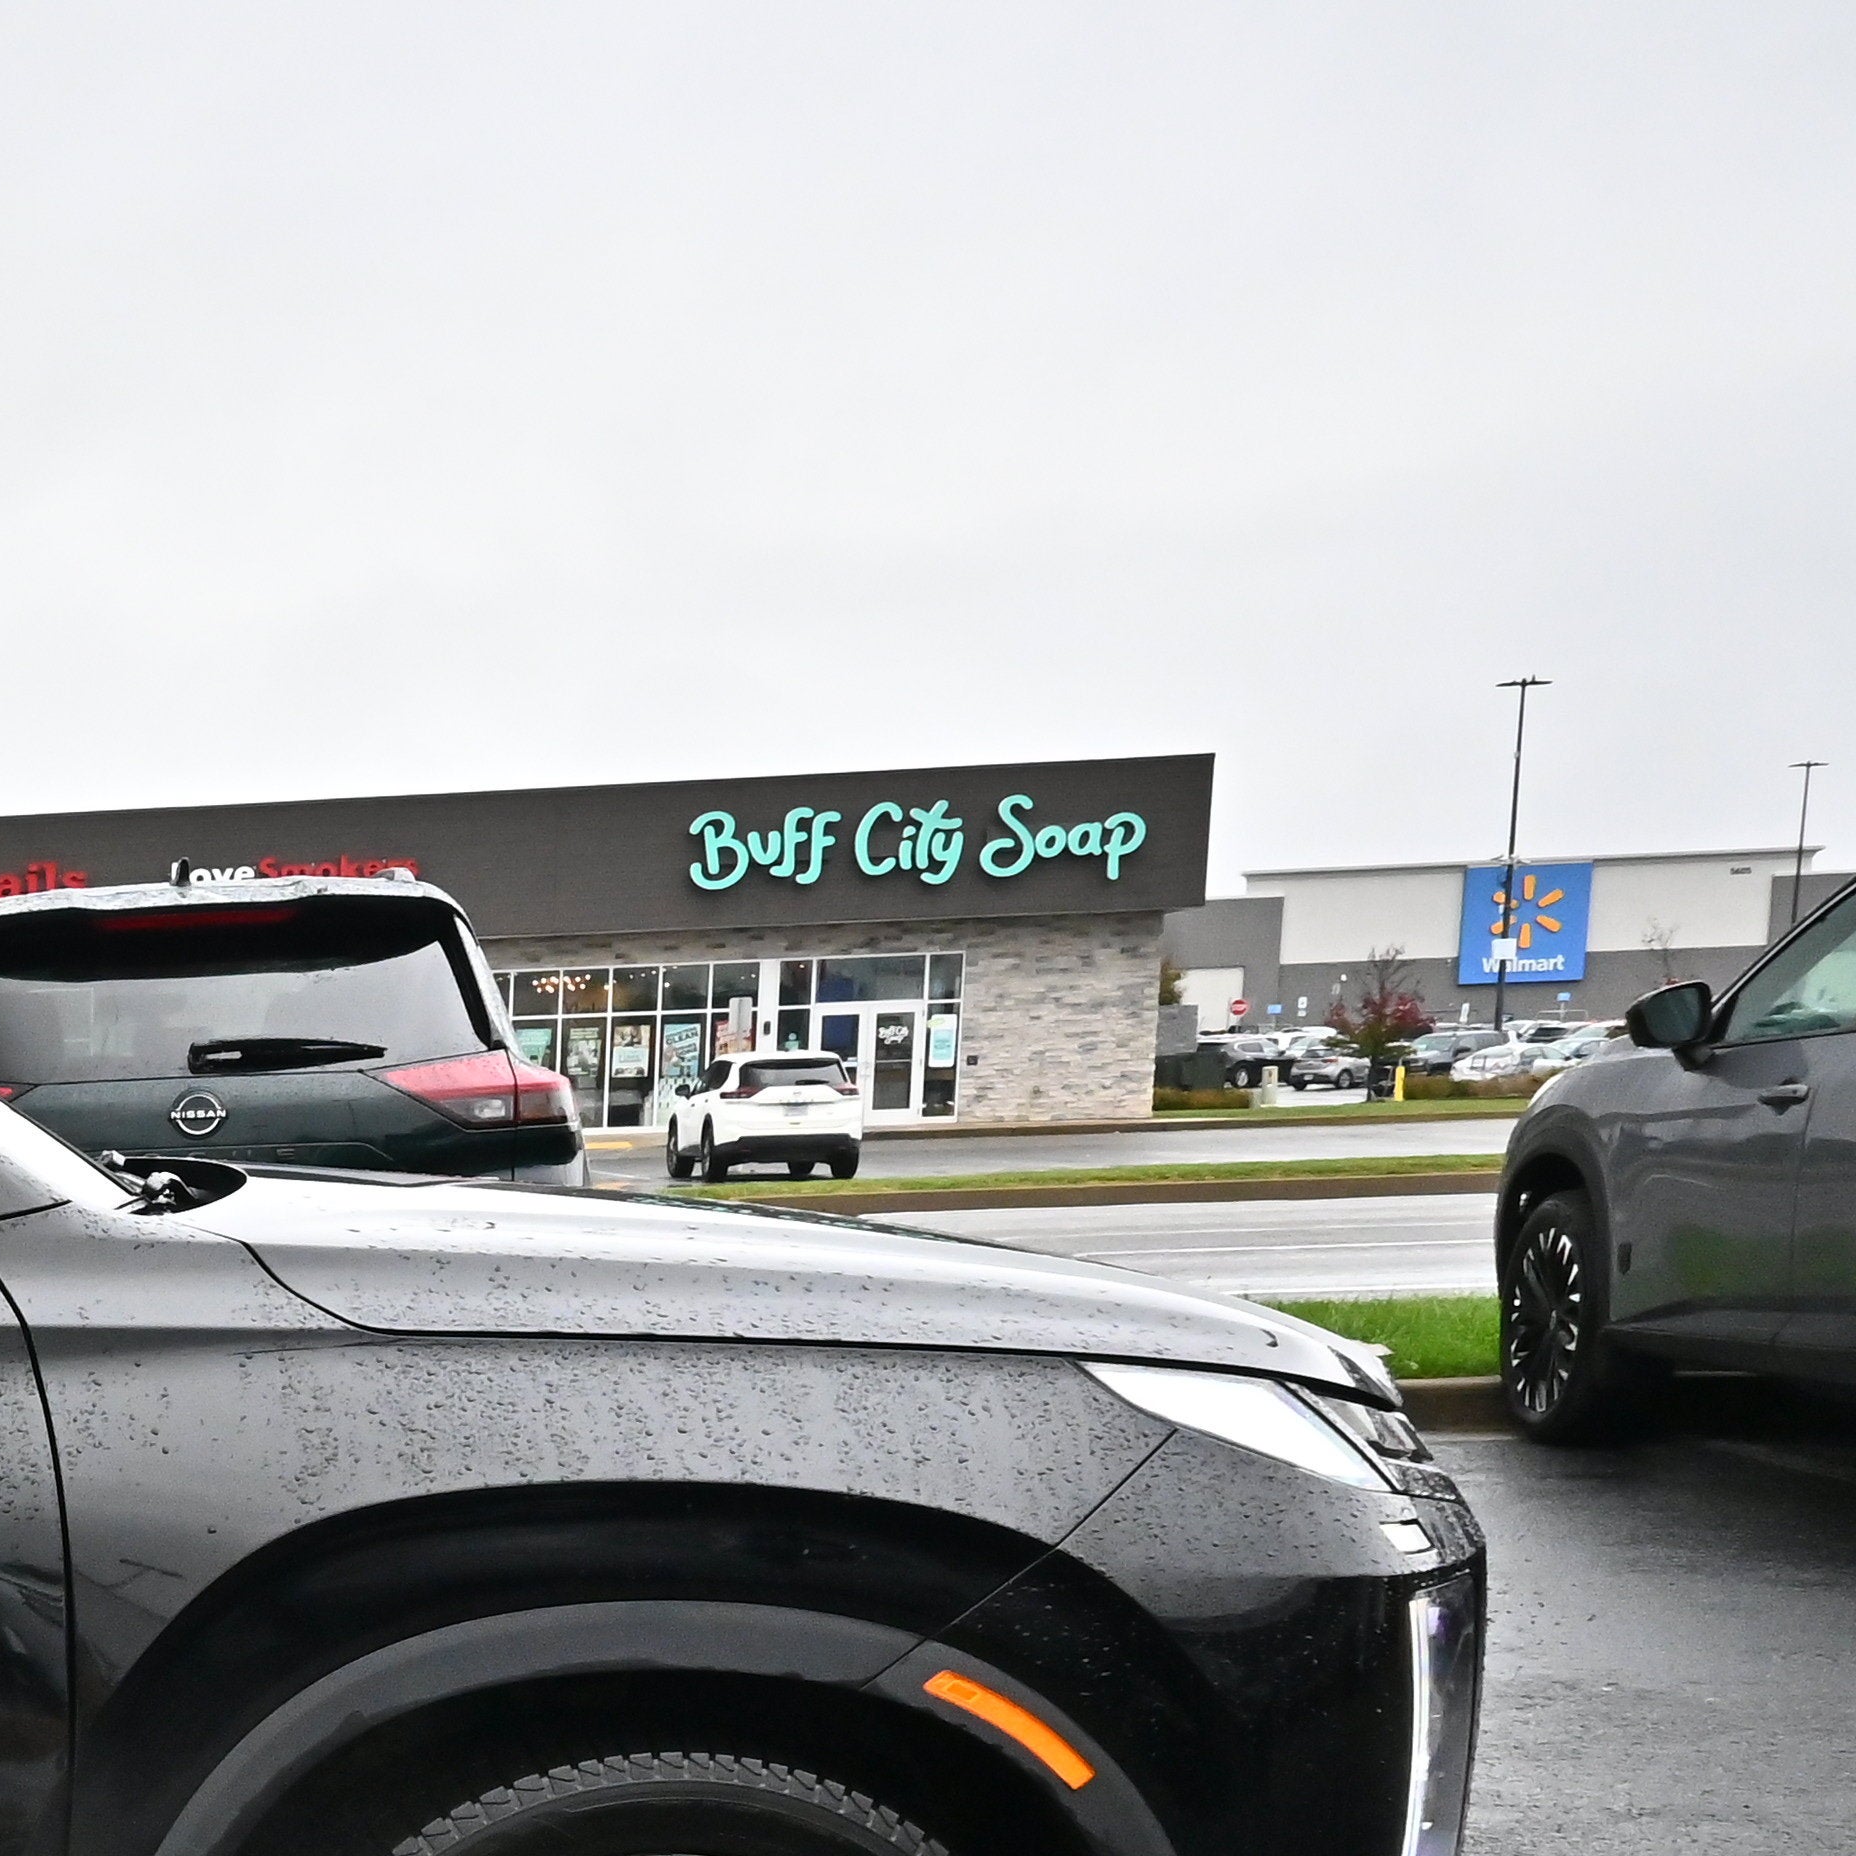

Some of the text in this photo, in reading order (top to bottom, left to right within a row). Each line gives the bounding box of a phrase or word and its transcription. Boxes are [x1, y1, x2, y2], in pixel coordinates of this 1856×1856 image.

[689, 794, 1147, 890] Buff City Soap
[170, 1108, 226, 1120] NISSAN
